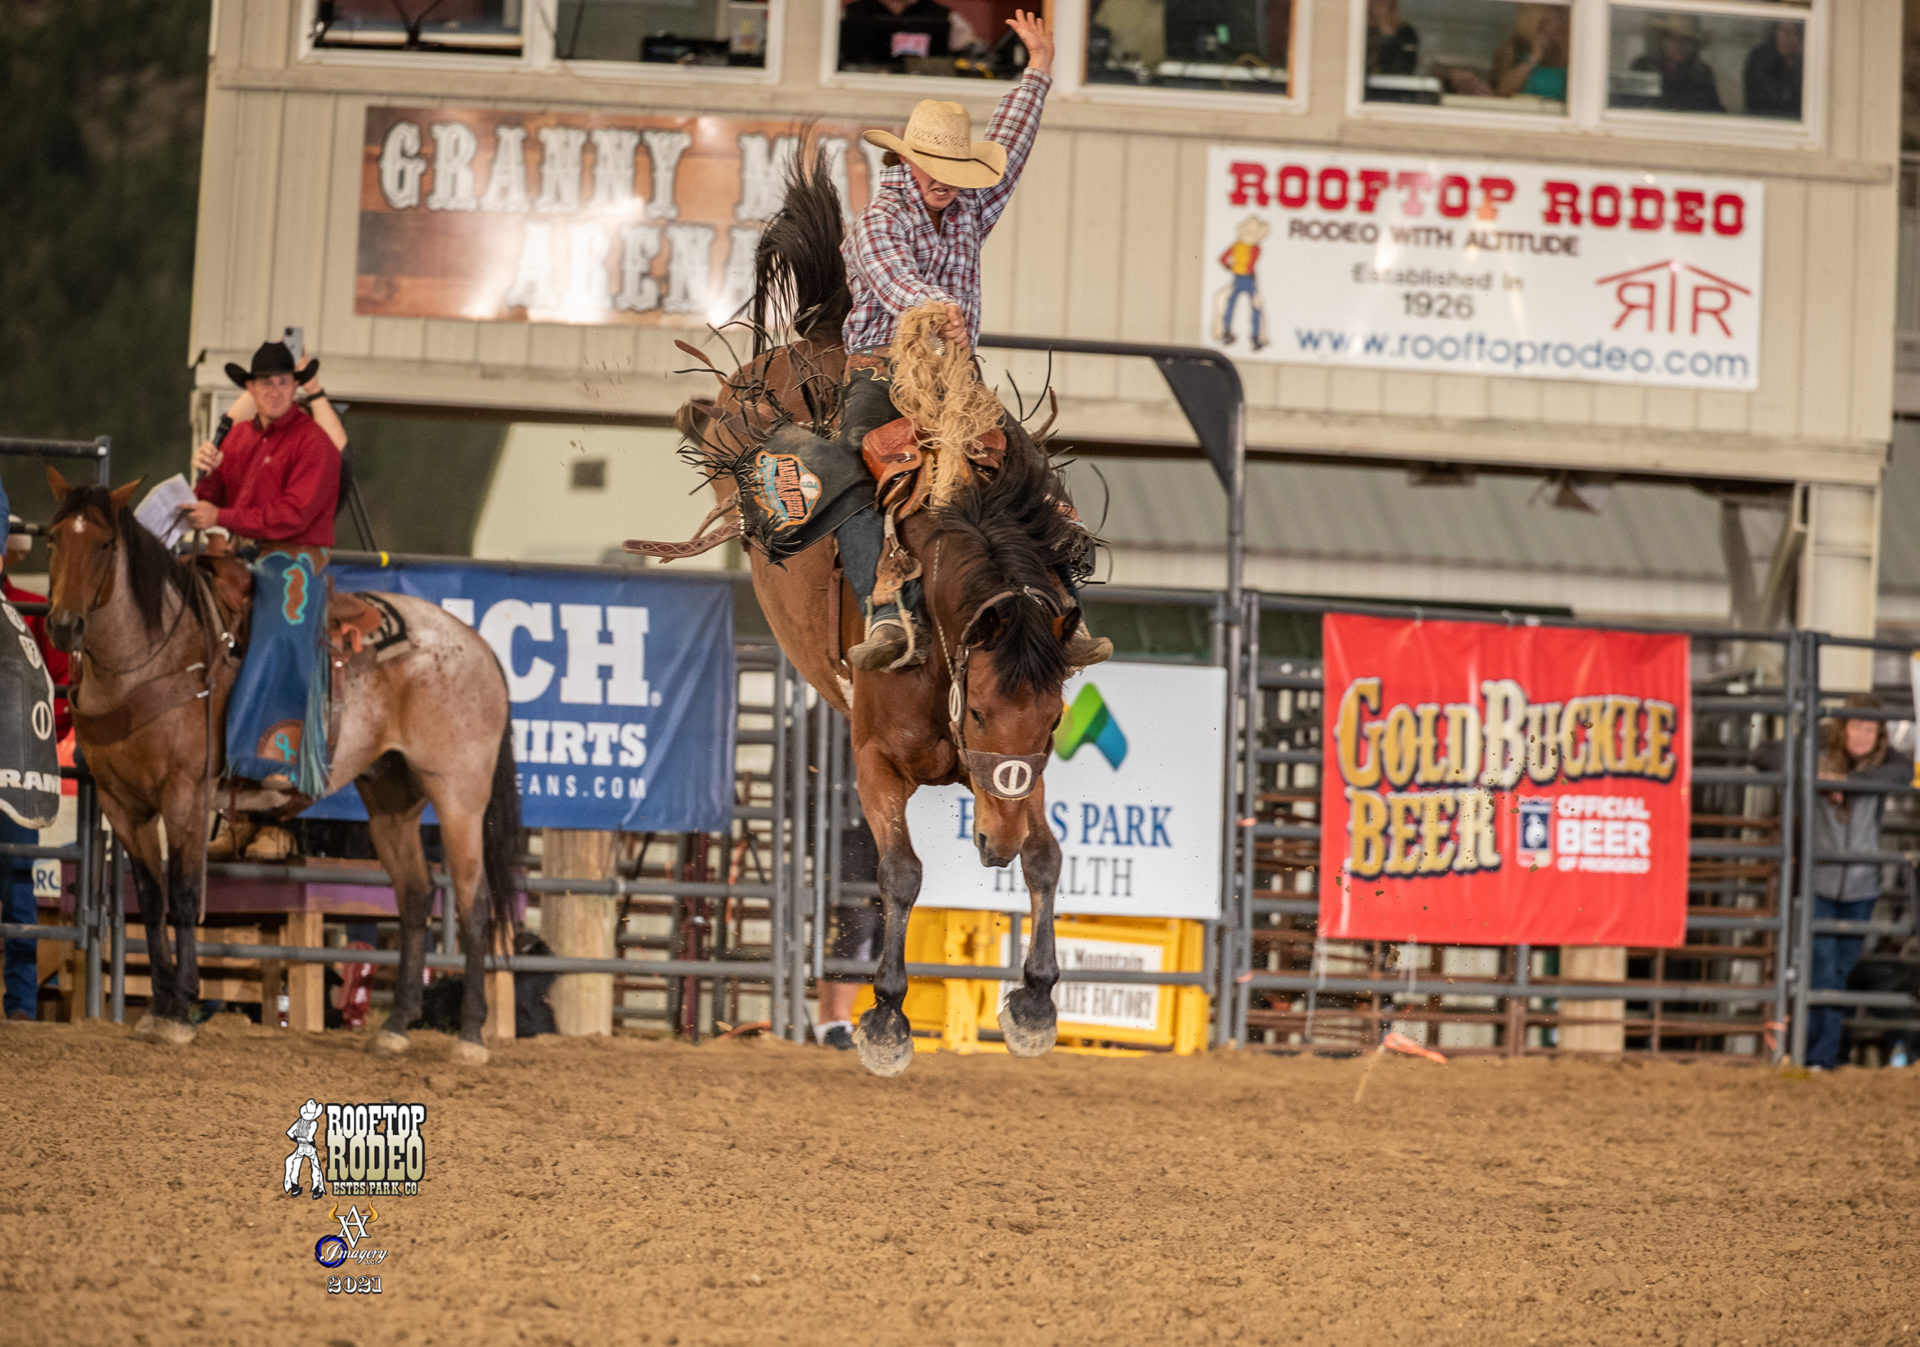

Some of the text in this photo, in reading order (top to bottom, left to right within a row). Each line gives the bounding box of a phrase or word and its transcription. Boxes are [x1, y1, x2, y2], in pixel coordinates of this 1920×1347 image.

[378, 119, 692, 220] GRANNY
[1227, 161, 1746, 237] ROOFTOP RODEO
[1288, 219, 1583, 257] RODEO WITH ALTITUDE
[1403, 290, 1476, 320] 1926
[1080, 802, 1172, 847] PARK
[1557, 794, 1651, 821] OFFICIAL
[1343, 786, 1502, 882] BEER
[1557, 818, 1652, 857] BEER
[993, 855, 1134, 897] HLTH
